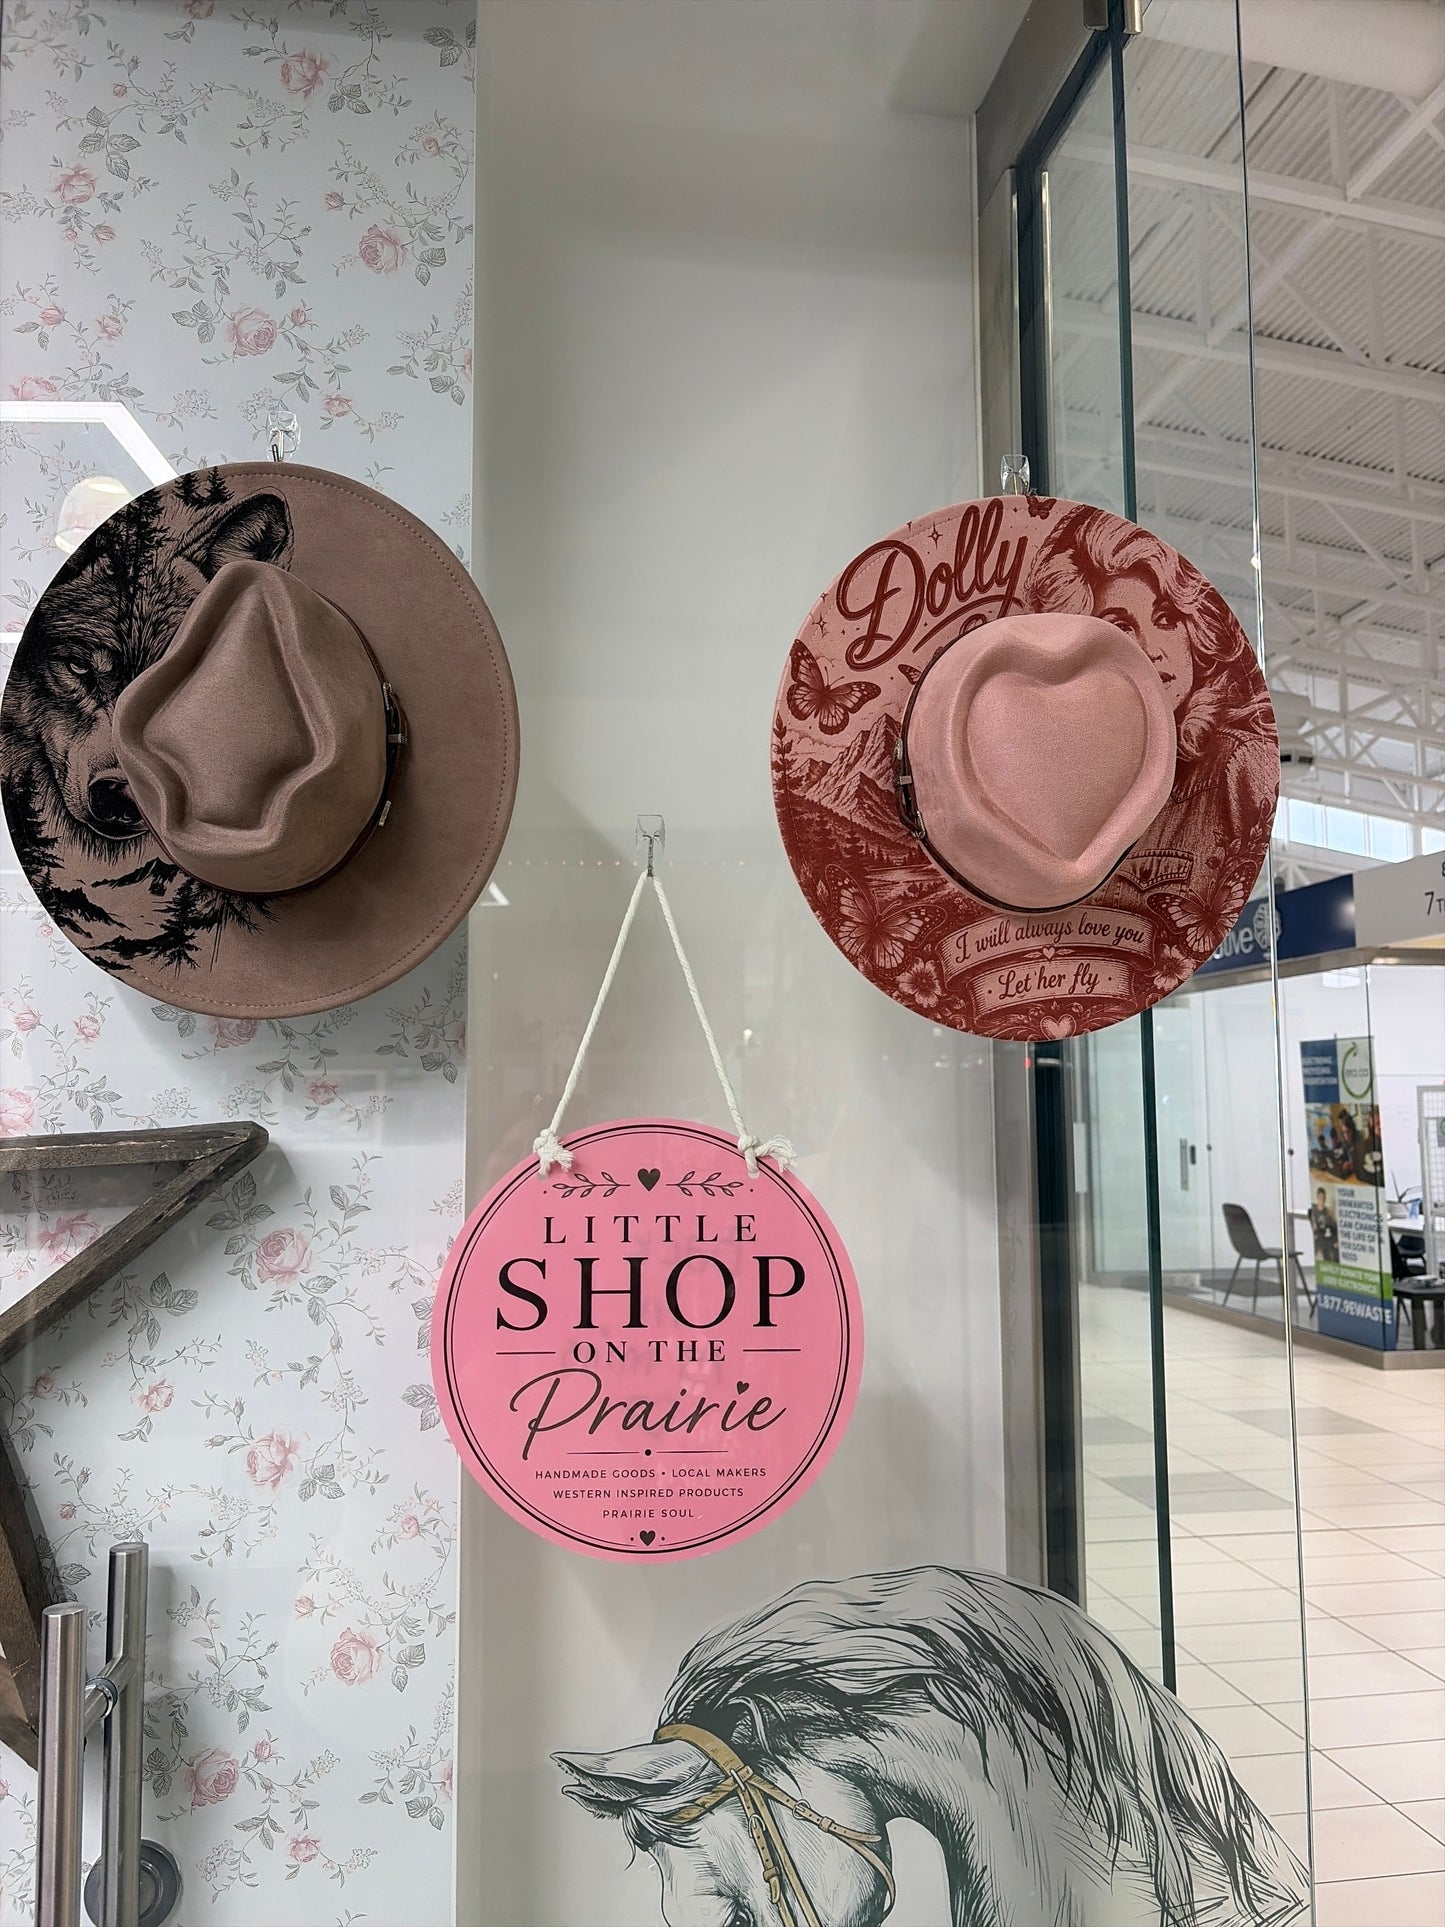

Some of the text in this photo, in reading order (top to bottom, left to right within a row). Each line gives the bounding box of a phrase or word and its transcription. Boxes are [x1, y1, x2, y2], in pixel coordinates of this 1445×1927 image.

[836, 498, 1028, 671] Dolly
[1424, 891, 1445, 916] 7T
[955, 931, 972, 963] I
[1015, 916, 1072, 944] always
[1078, 911, 1111, 936] love
[1115, 924, 1145, 946] you
[998, 962, 1100, 1000] Let her fly
[543, 1214, 757, 1245] LITTLE
[495, 1254, 806, 1332] SHOP
[572, 1339, 726, 1364] ON THE
[509, 1367, 787, 1461] Prairie
[535, 1467, 767, 1480] HANDMADE GOODS LOCAL MAKERS
[552, 1487, 744, 1499] WESTERN INSPIRED PRODUCTS
[602, 1508, 695, 1519] PRAIRIE SOUL
